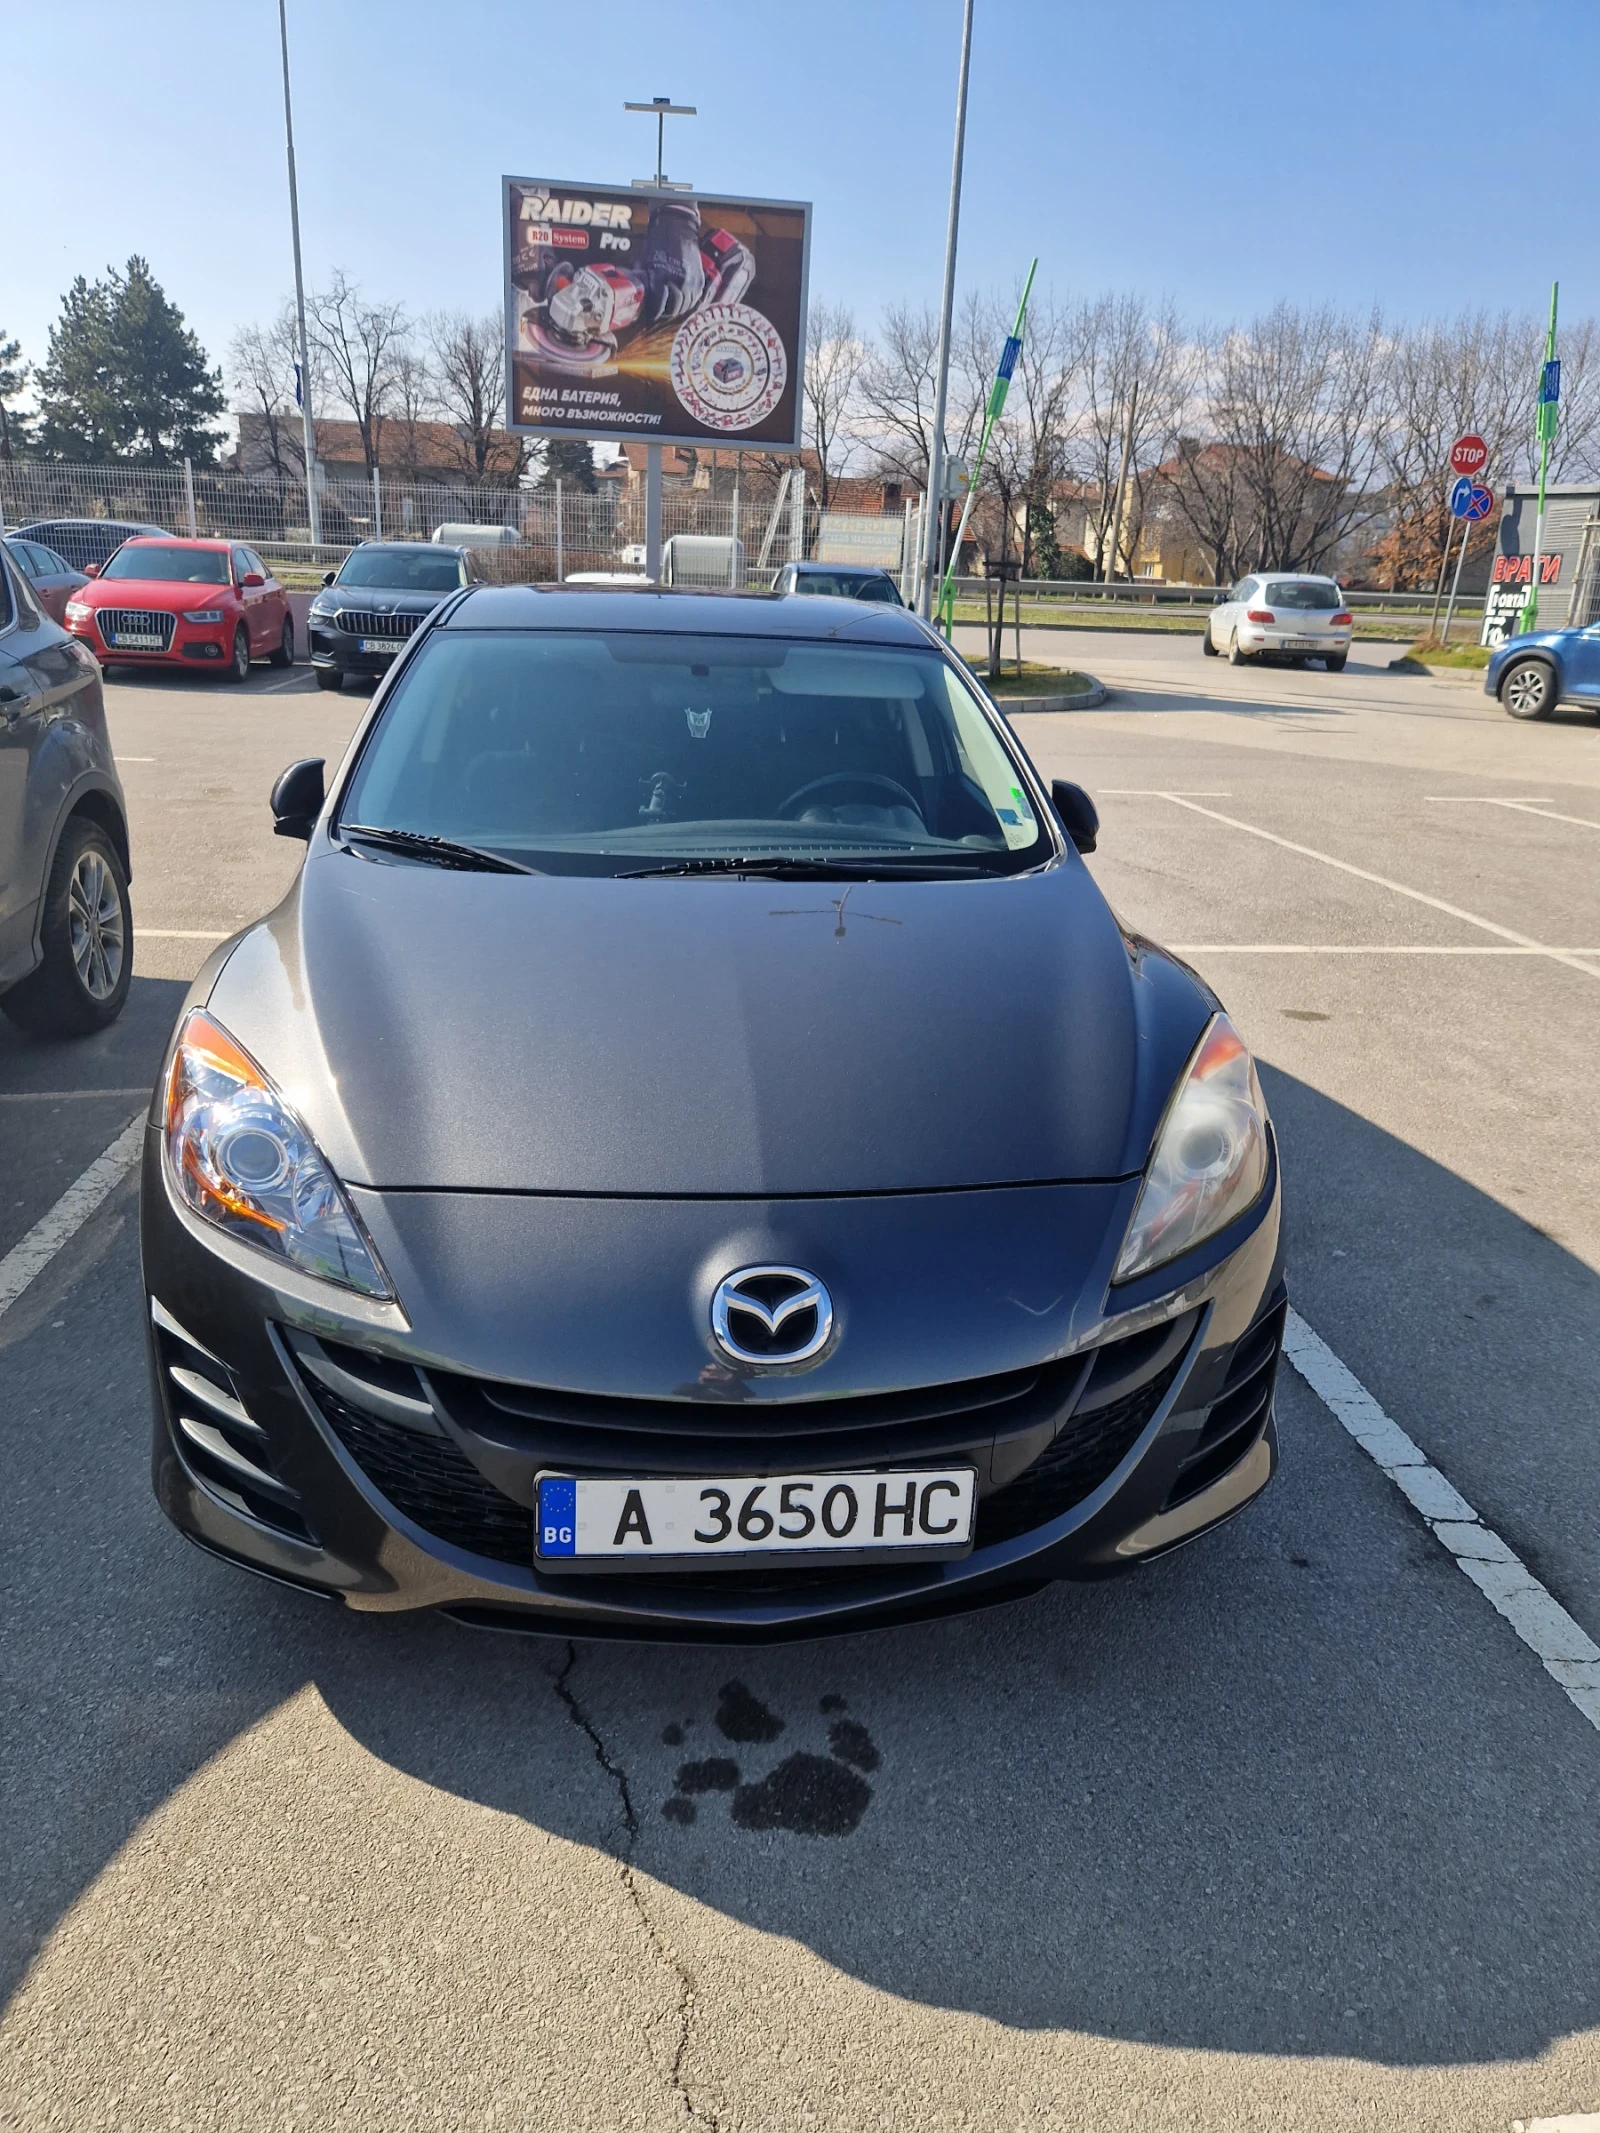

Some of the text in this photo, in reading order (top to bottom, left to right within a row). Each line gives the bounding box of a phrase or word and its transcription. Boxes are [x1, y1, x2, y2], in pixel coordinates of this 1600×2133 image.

[520, 196, 632, 229] RAIDER
[532, 231, 586, 245] R20 System
[600, 232, 631, 251] Pro
[522, 386, 621, 407] ЕДНА БАТЕРИЯ,
[522, 405, 662, 425] МНОГО ВЪЗМОЖНОСТИ!
[1453, 447, 1484, 463] STOP
[544, 1480, 960, 1545] BG A 3650 HC
